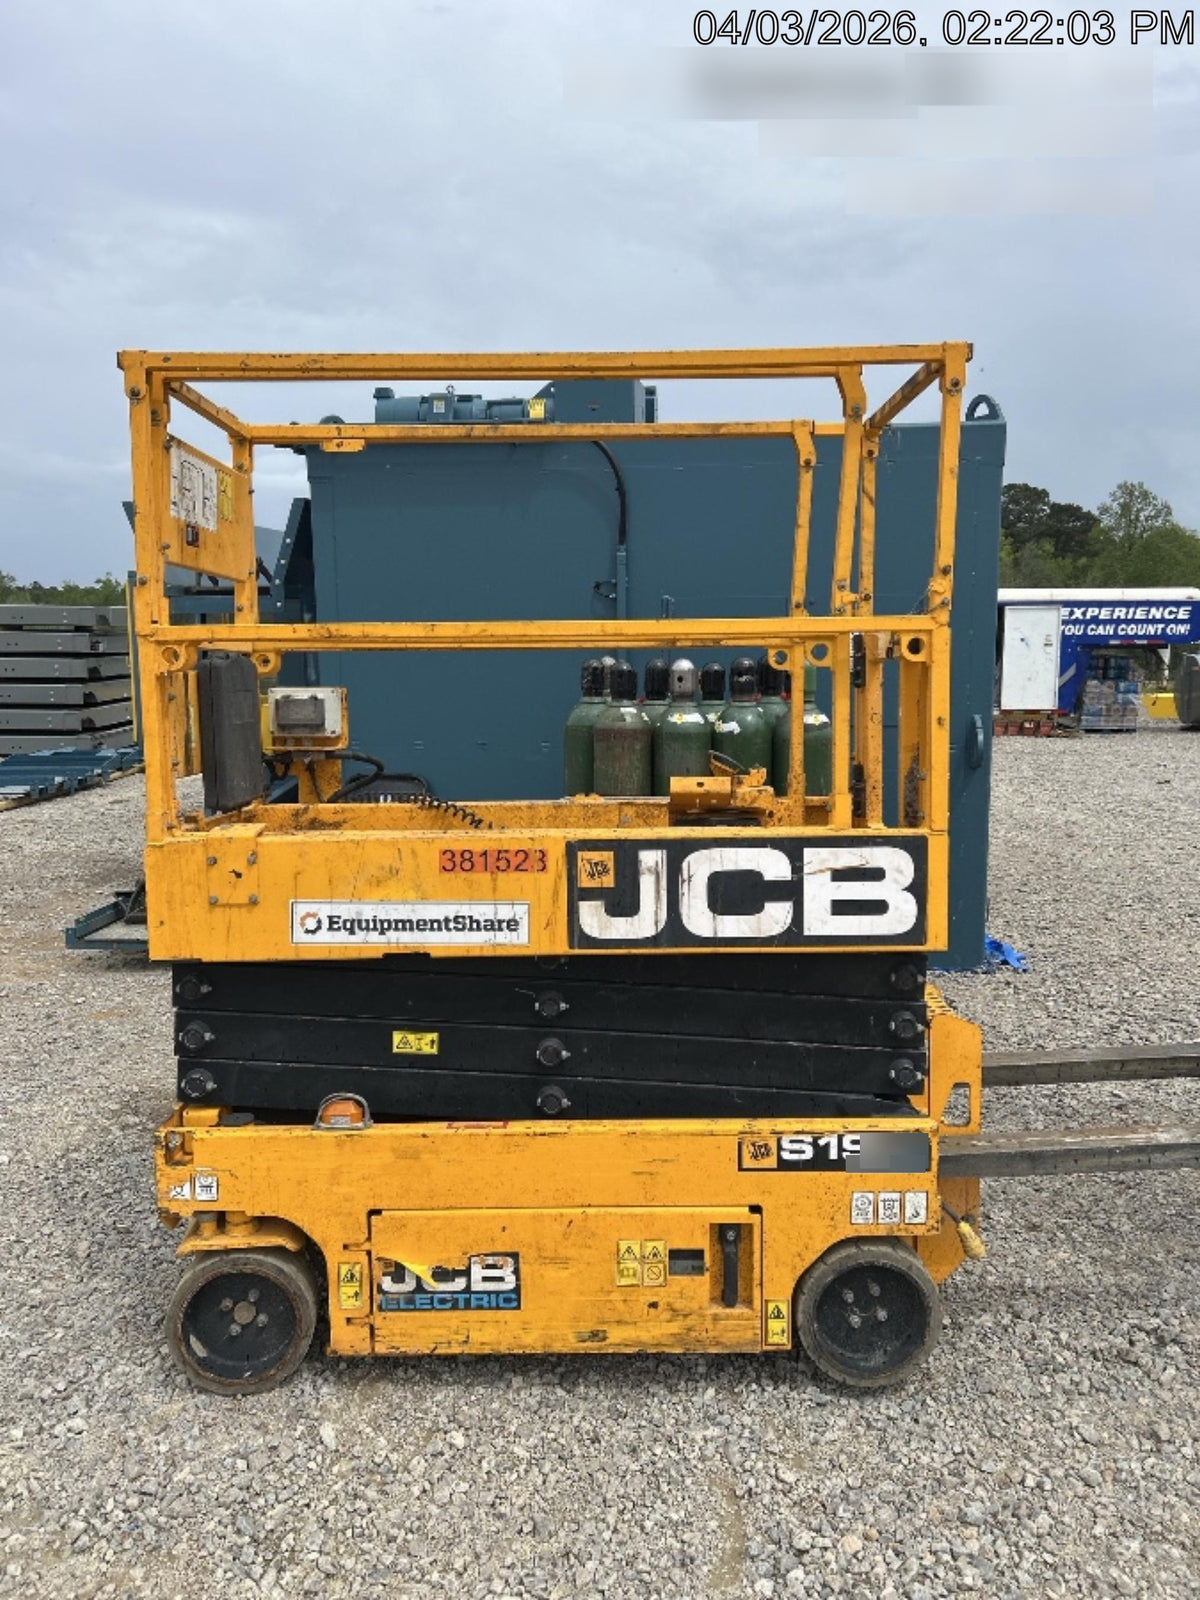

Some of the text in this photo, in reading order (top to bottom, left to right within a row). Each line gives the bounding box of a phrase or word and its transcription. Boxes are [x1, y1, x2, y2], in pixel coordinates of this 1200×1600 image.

[1061, 607, 1191, 619] EXPERIENCE
[1087, 624, 1115, 635] CAN
[1118, 624, 1165, 635] COUNT
[578, 847, 918, 939] JCB
[327, 915, 520, 935] EquipmentShare
[380, 1293, 518, 1310] ELECTRIC
